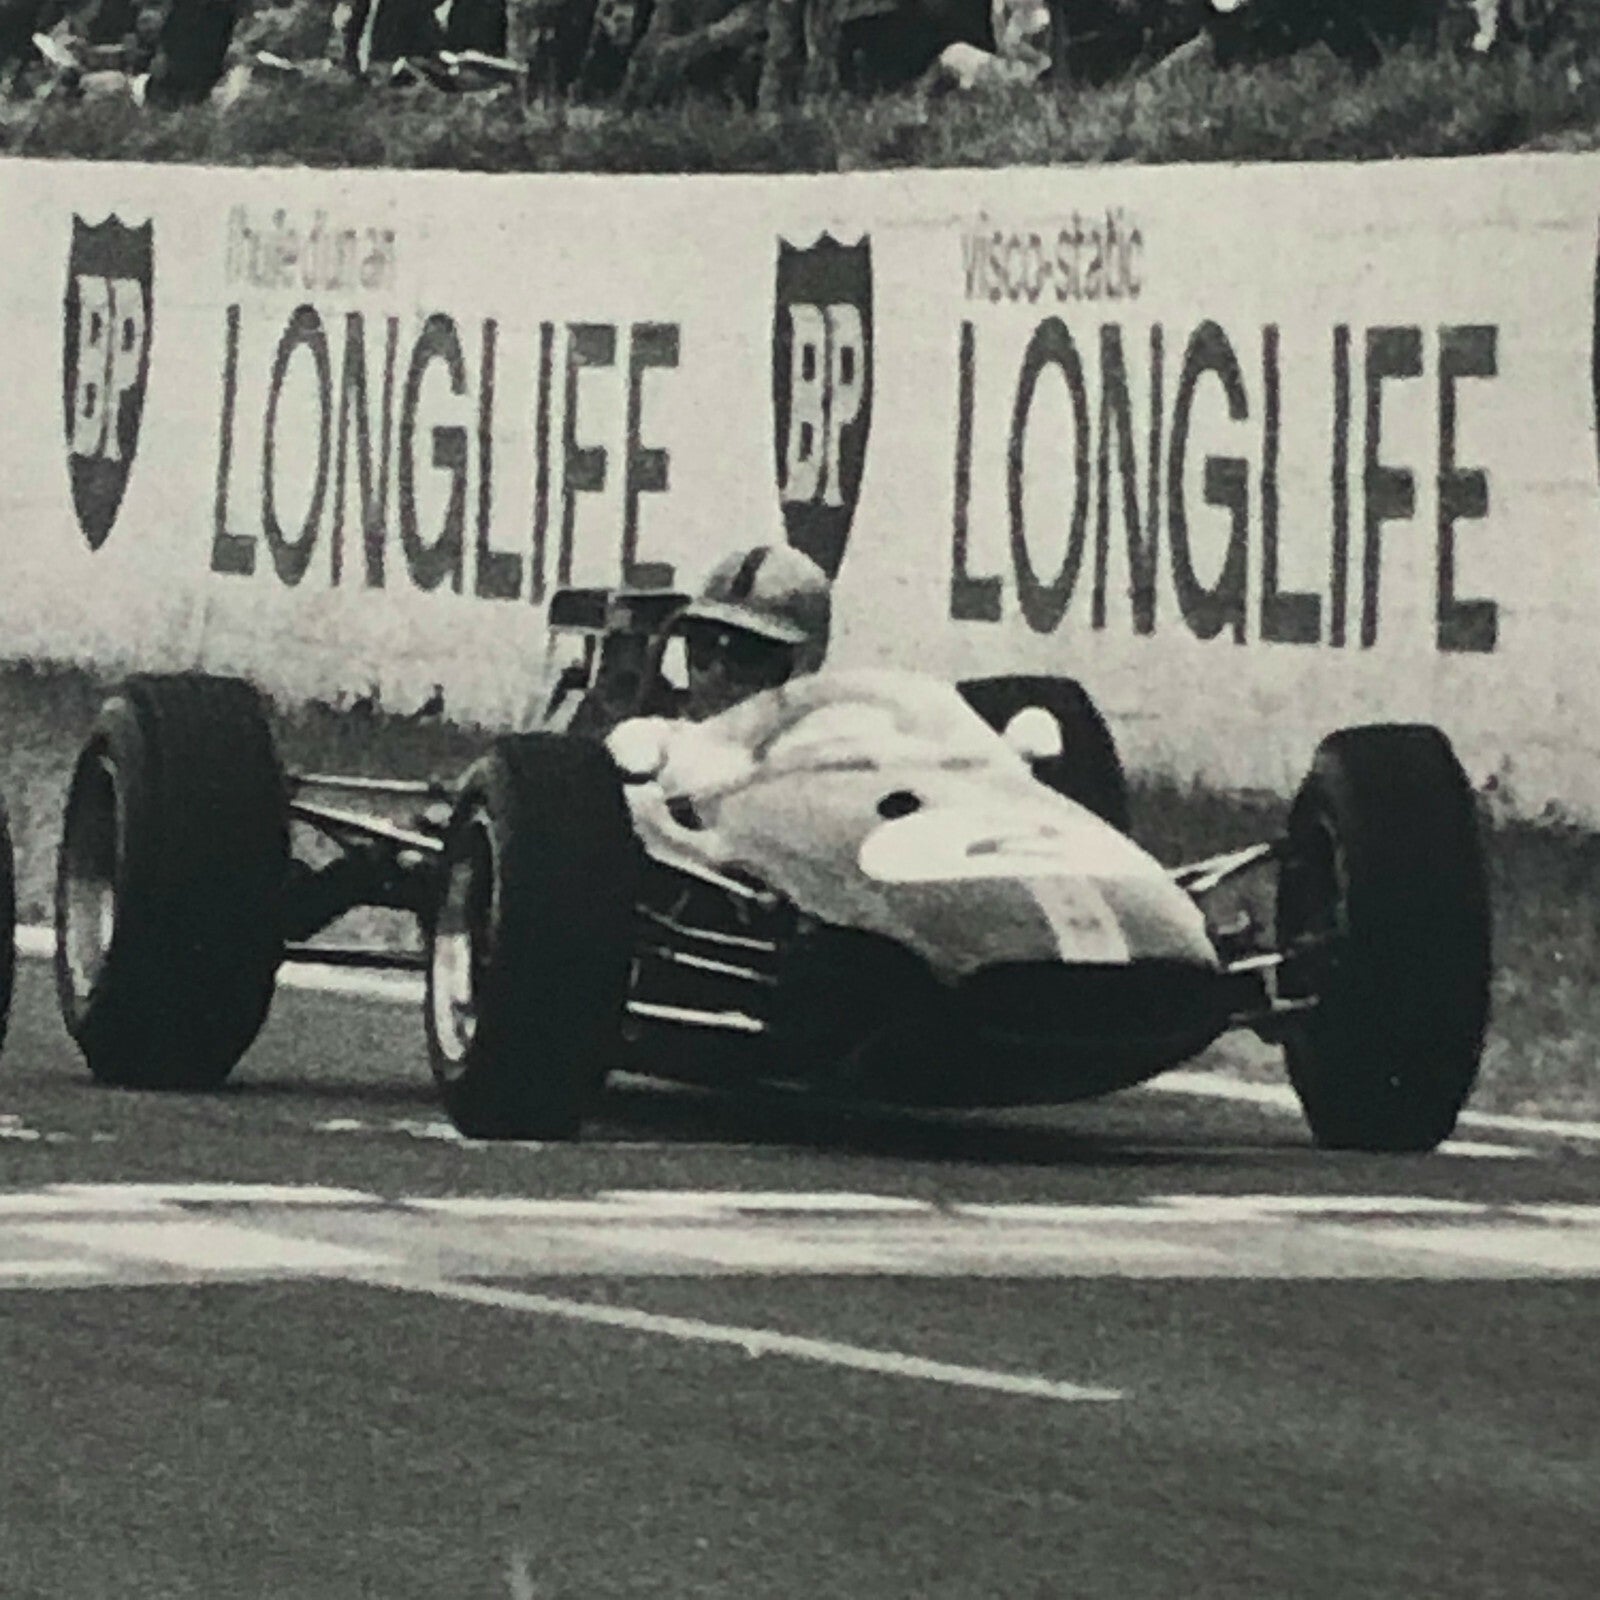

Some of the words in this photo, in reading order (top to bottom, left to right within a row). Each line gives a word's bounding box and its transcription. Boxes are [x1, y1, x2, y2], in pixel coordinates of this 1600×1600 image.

[69, 274, 145, 462] BP
[210, 303, 681, 605] LONGLIFE
[780, 302, 865, 507] BP
[950, 316, 1499, 653] LONGLIFE
